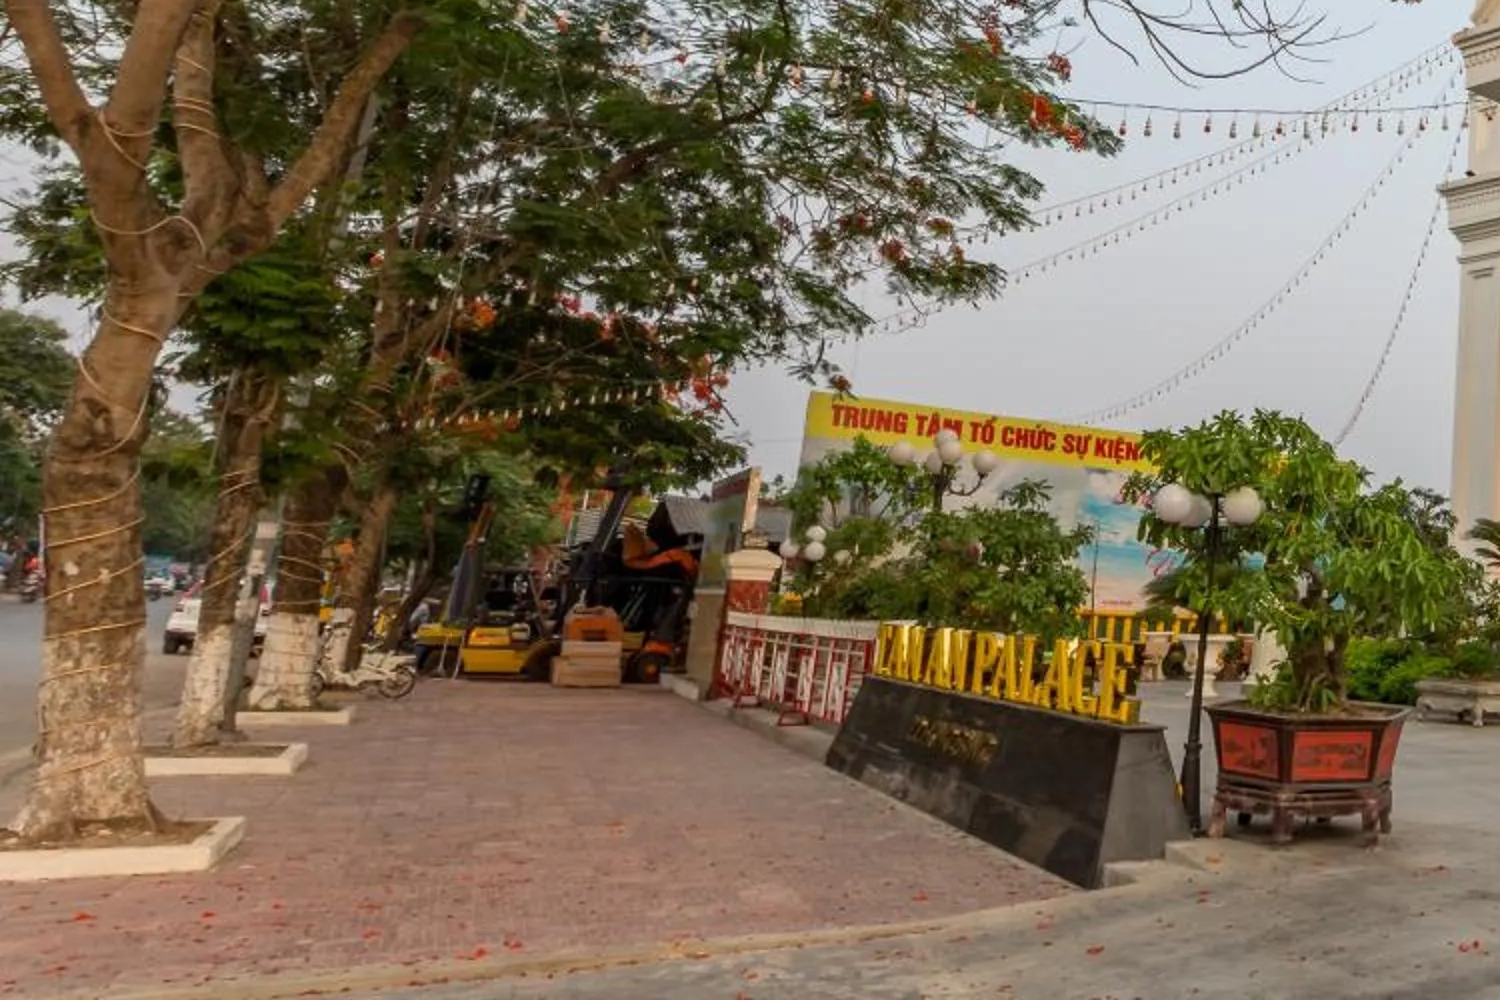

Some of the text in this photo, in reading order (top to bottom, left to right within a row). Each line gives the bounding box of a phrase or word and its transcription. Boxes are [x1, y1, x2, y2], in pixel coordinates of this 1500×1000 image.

[831, 403, 908, 434] TRUNG
[1001, 424, 1057, 451] CHỨC
[1062, 433, 1092, 460] SỰ
[970, 629, 1138, 724] PALACE
